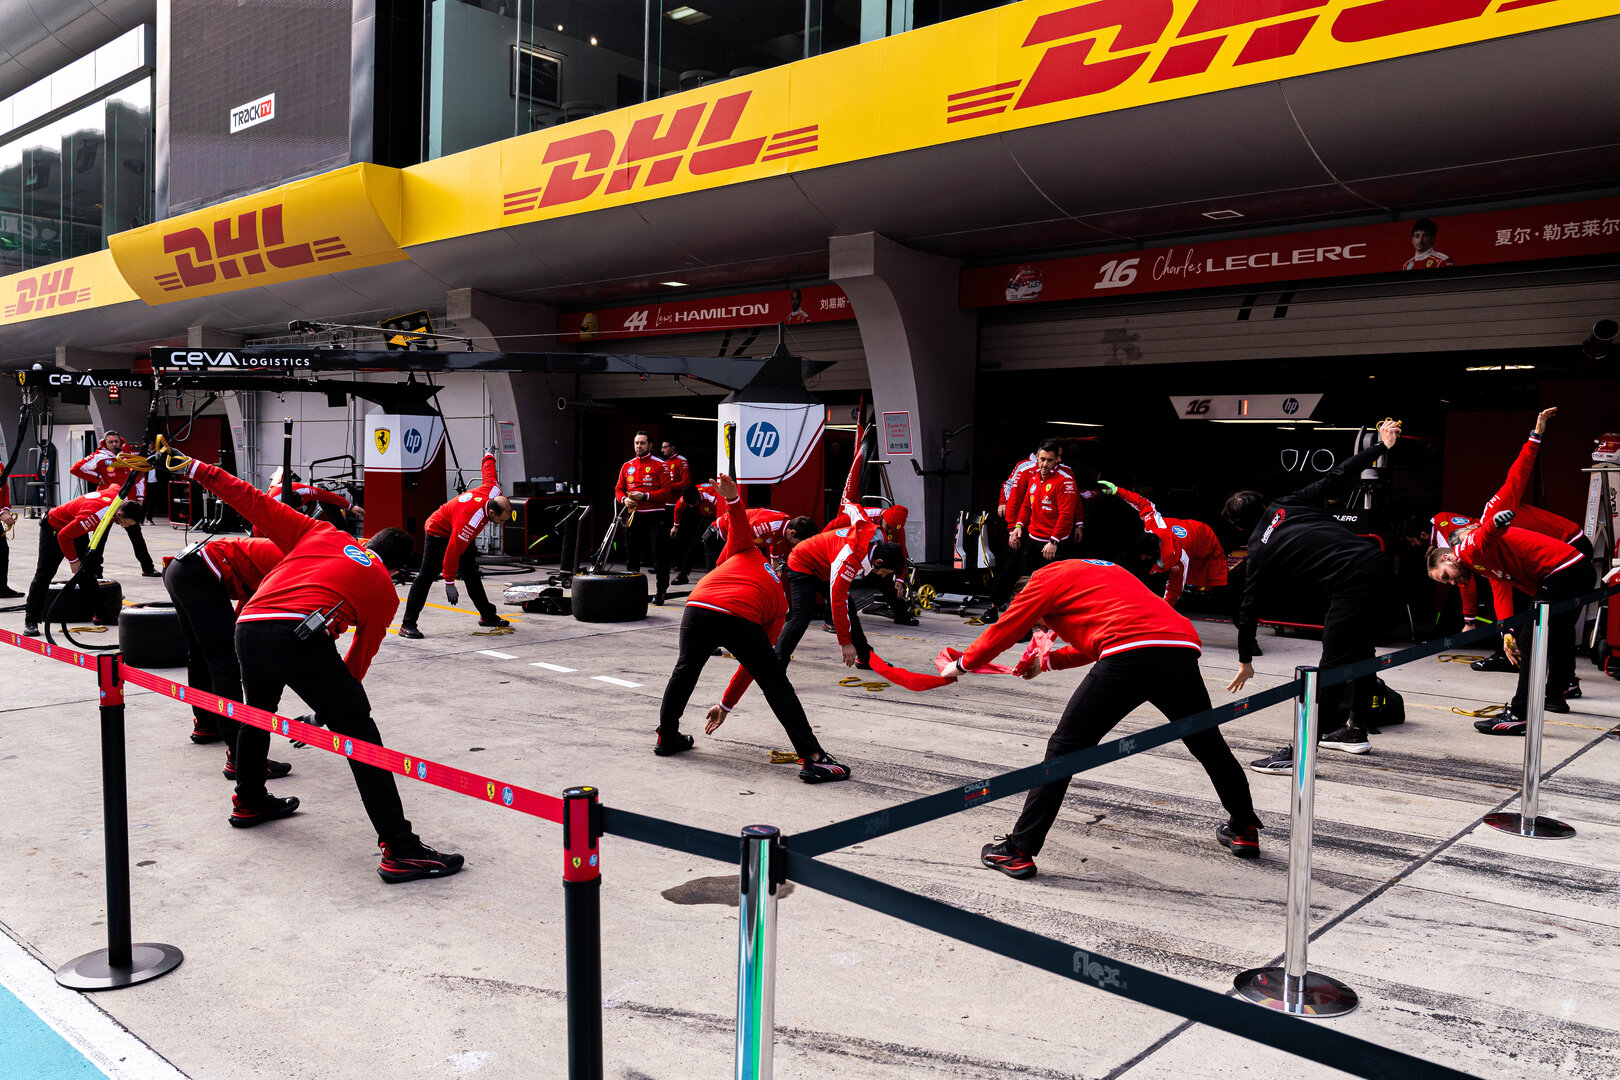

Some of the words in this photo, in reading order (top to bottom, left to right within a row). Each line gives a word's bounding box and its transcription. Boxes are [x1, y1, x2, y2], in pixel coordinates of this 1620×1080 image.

[538, 90, 768, 209] DHL
[163, 203, 316, 288] DHL
[1093, 257, 1141, 290] 16
[1152, 248, 1203, 281] Charles
[1206, 243, 1368, 272] LECLERC
[15, 266, 79, 316] DHL
[623, 310, 649, 332] 44
[655, 307, 674, 327] Lewis
[674, 303, 770, 322] HAMILTON
[241, 357, 311, 367] LOGISTICS
[97, 380, 143, 388] LOGISTICS
[1185, 398, 1213, 416] 16
[1282, 398, 1300, 415] hp
[403, 428, 423, 454] hp
[746, 421, 780, 458] hp
[417, 761, 427, 779] hp
[502, 786, 514, 805] hp
